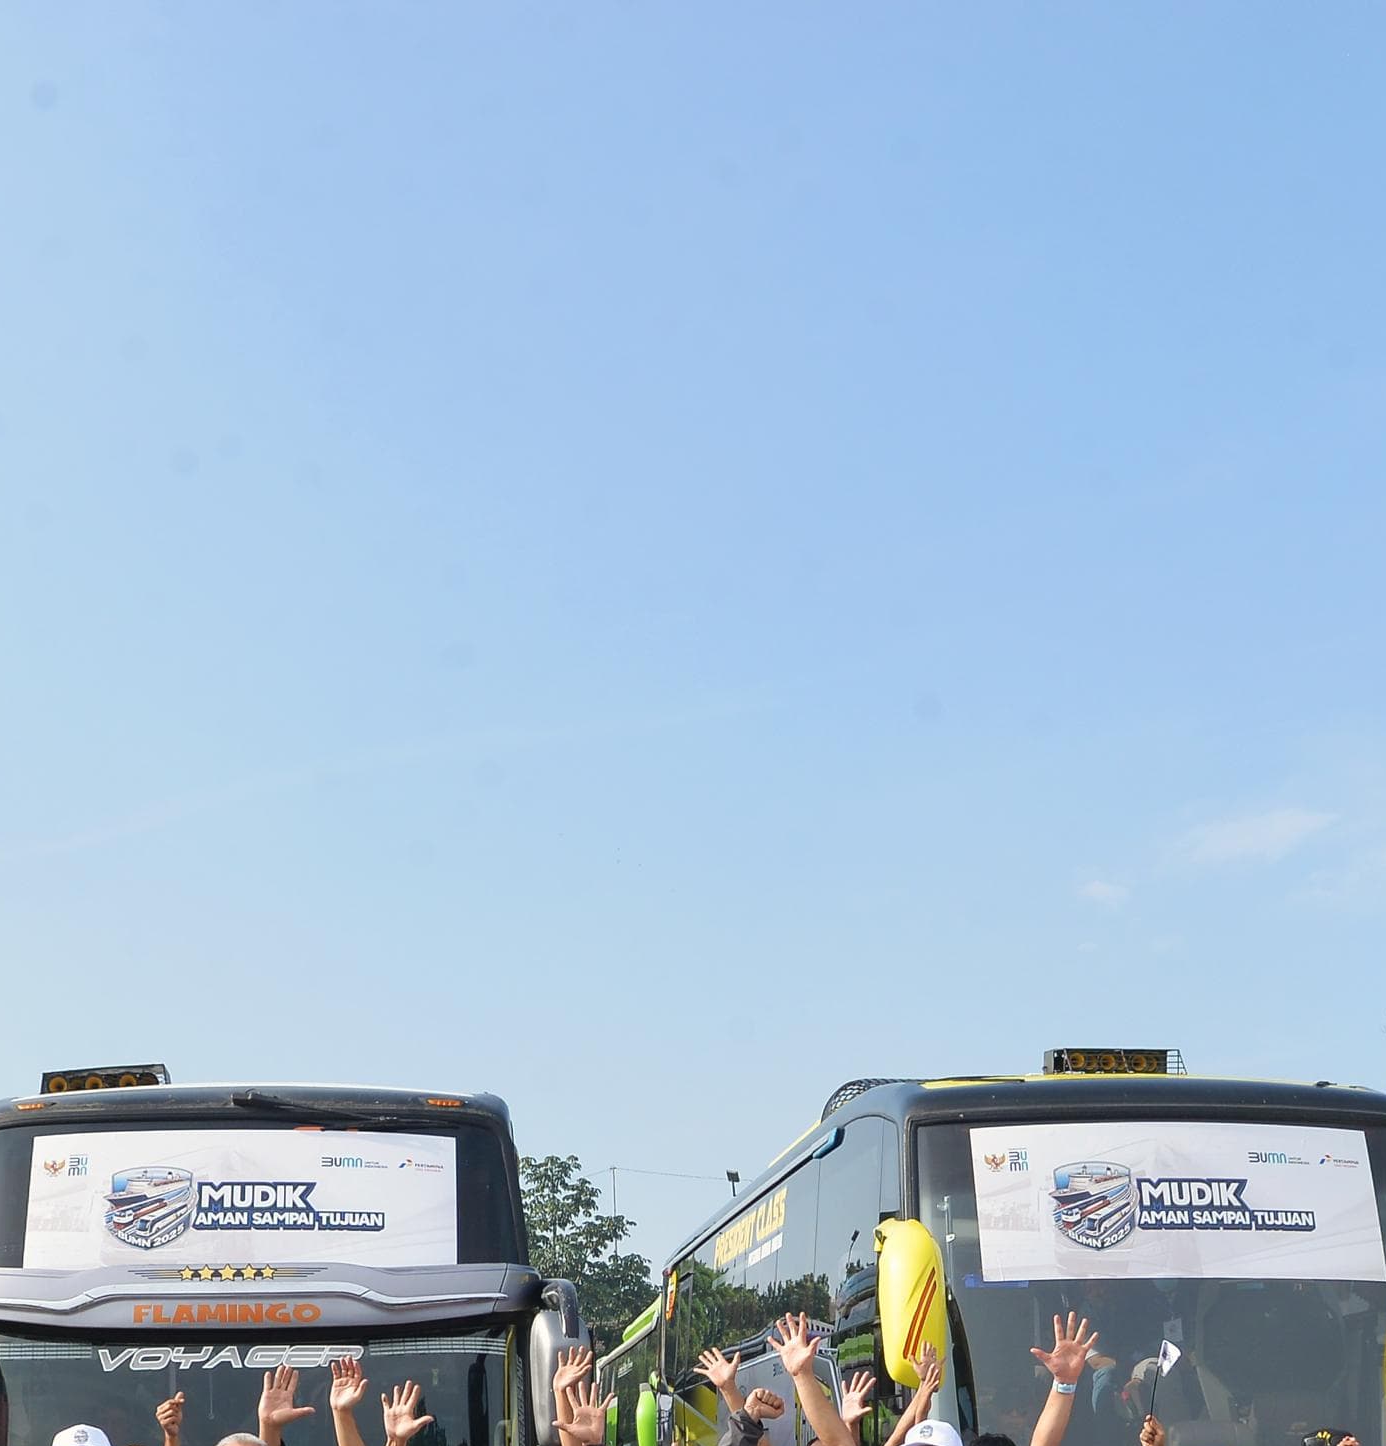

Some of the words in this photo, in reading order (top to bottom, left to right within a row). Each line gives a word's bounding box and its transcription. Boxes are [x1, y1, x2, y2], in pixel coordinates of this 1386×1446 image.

[201, 1184, 309, 1208] MUDIK
[1141, 1181, 1242, 1207] MUDIK
[195, 1211, 248, 1225] AMAN
[252, 1211, 313, 1225] SAMPAI
[318, 1212, 383, 1227] TUJUAN
[1140, 1211, 1189, 1225] AMAN
[1193, 1211, 1250, 1225] SAMPAI
[1254, 1211, 1314, 1226] TUJUAN
[117, 1230, 151, 1248] BUMN
[153, 1224, 185, 1247] 2025
[1067, 1229, 1102, 1248] BUMN
[1103, 1223, 1132, 1247] 2025
[133, 1303, 322, 1326] FLAMINGO
[98, 1344, 365, 1373] VOYAGER
